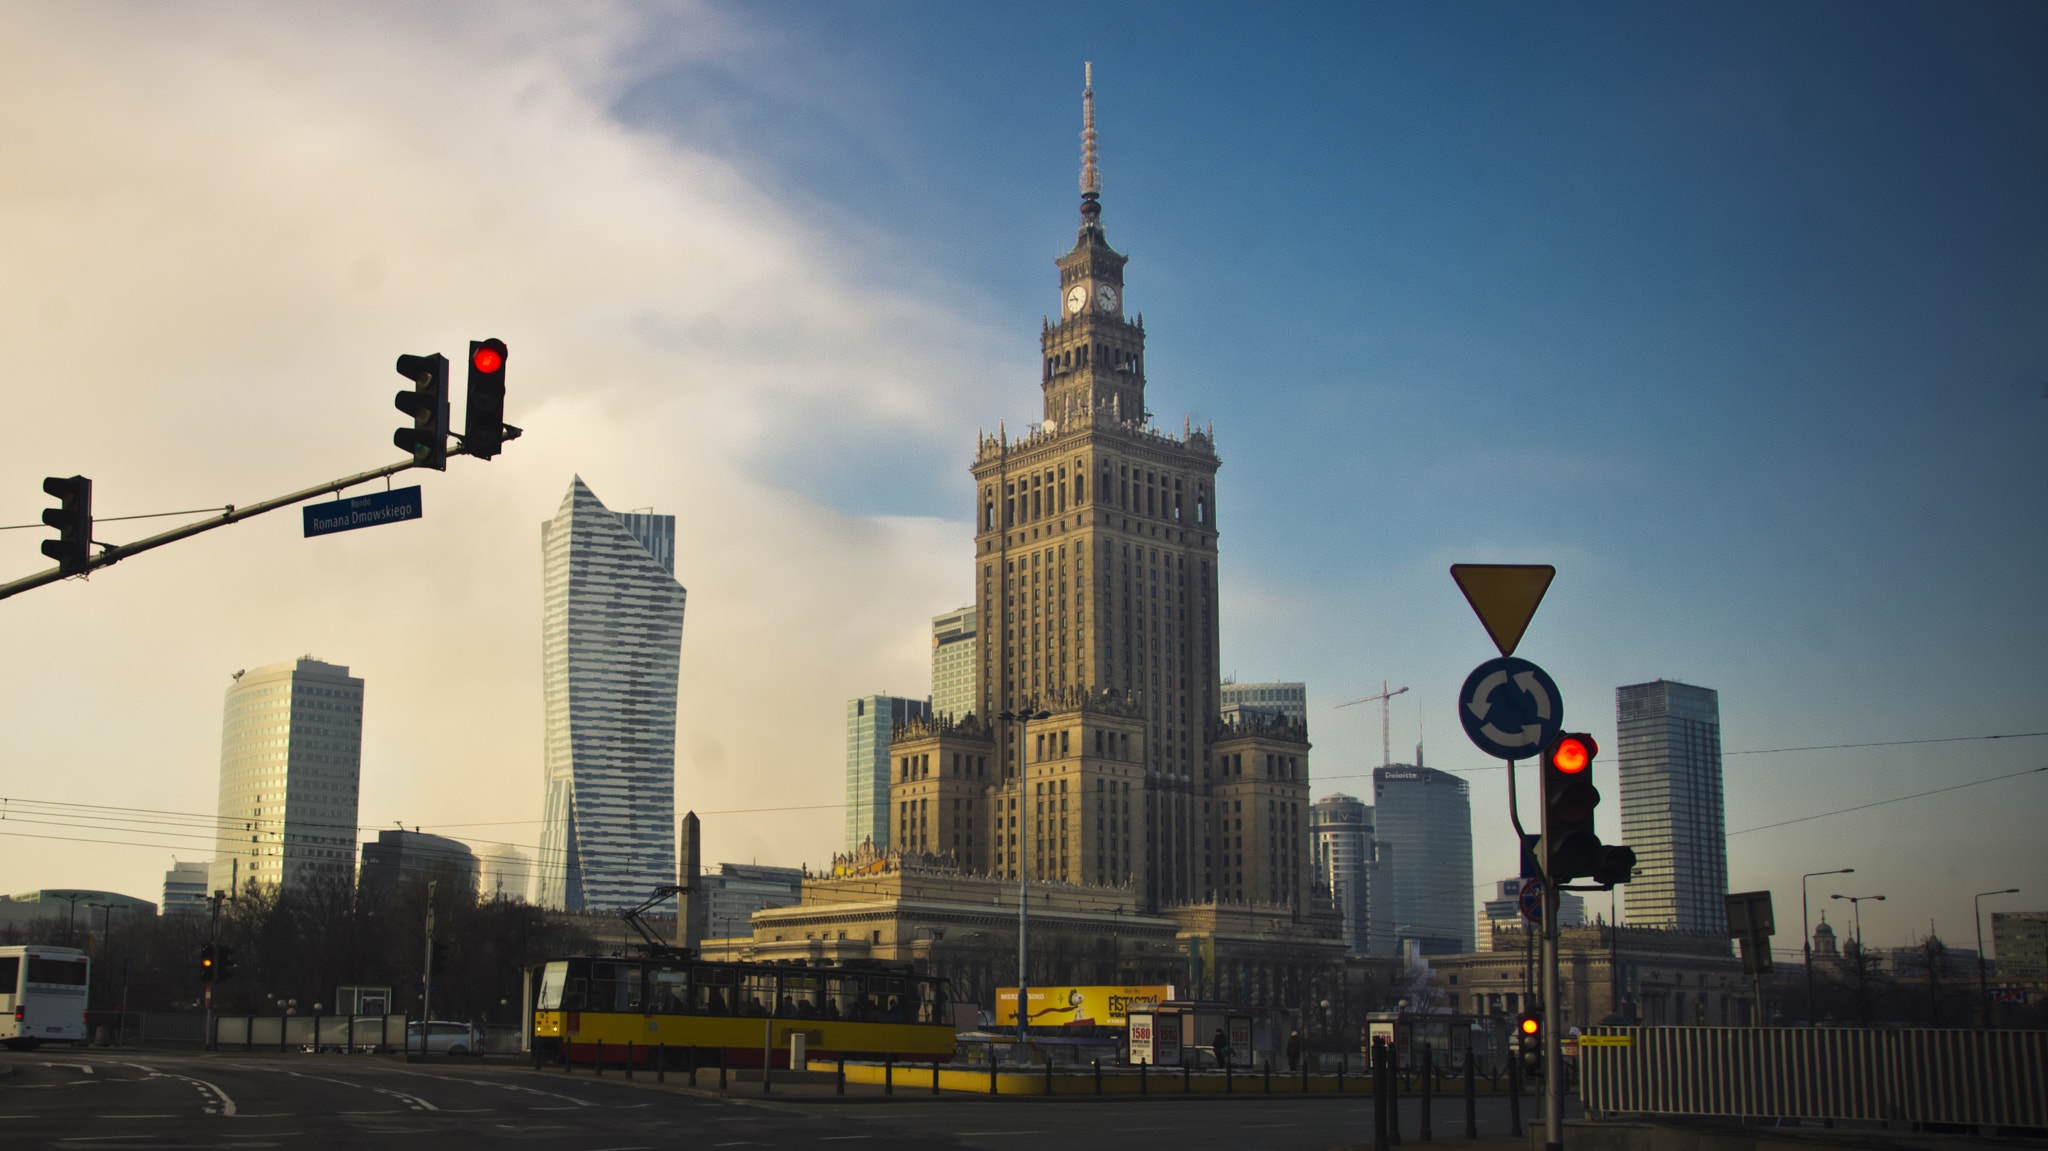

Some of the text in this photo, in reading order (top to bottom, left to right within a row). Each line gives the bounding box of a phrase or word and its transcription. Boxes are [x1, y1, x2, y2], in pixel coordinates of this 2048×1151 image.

[351, 497, 372, 508] Rondo
[313, 504, 412, 531] Romana Dmowskiego
[1385, 771, 1417, 779] Deloitte
[1990, 990, 2024, 1004] TAXI
[1131, 1027, 1151, 1039] 1580
